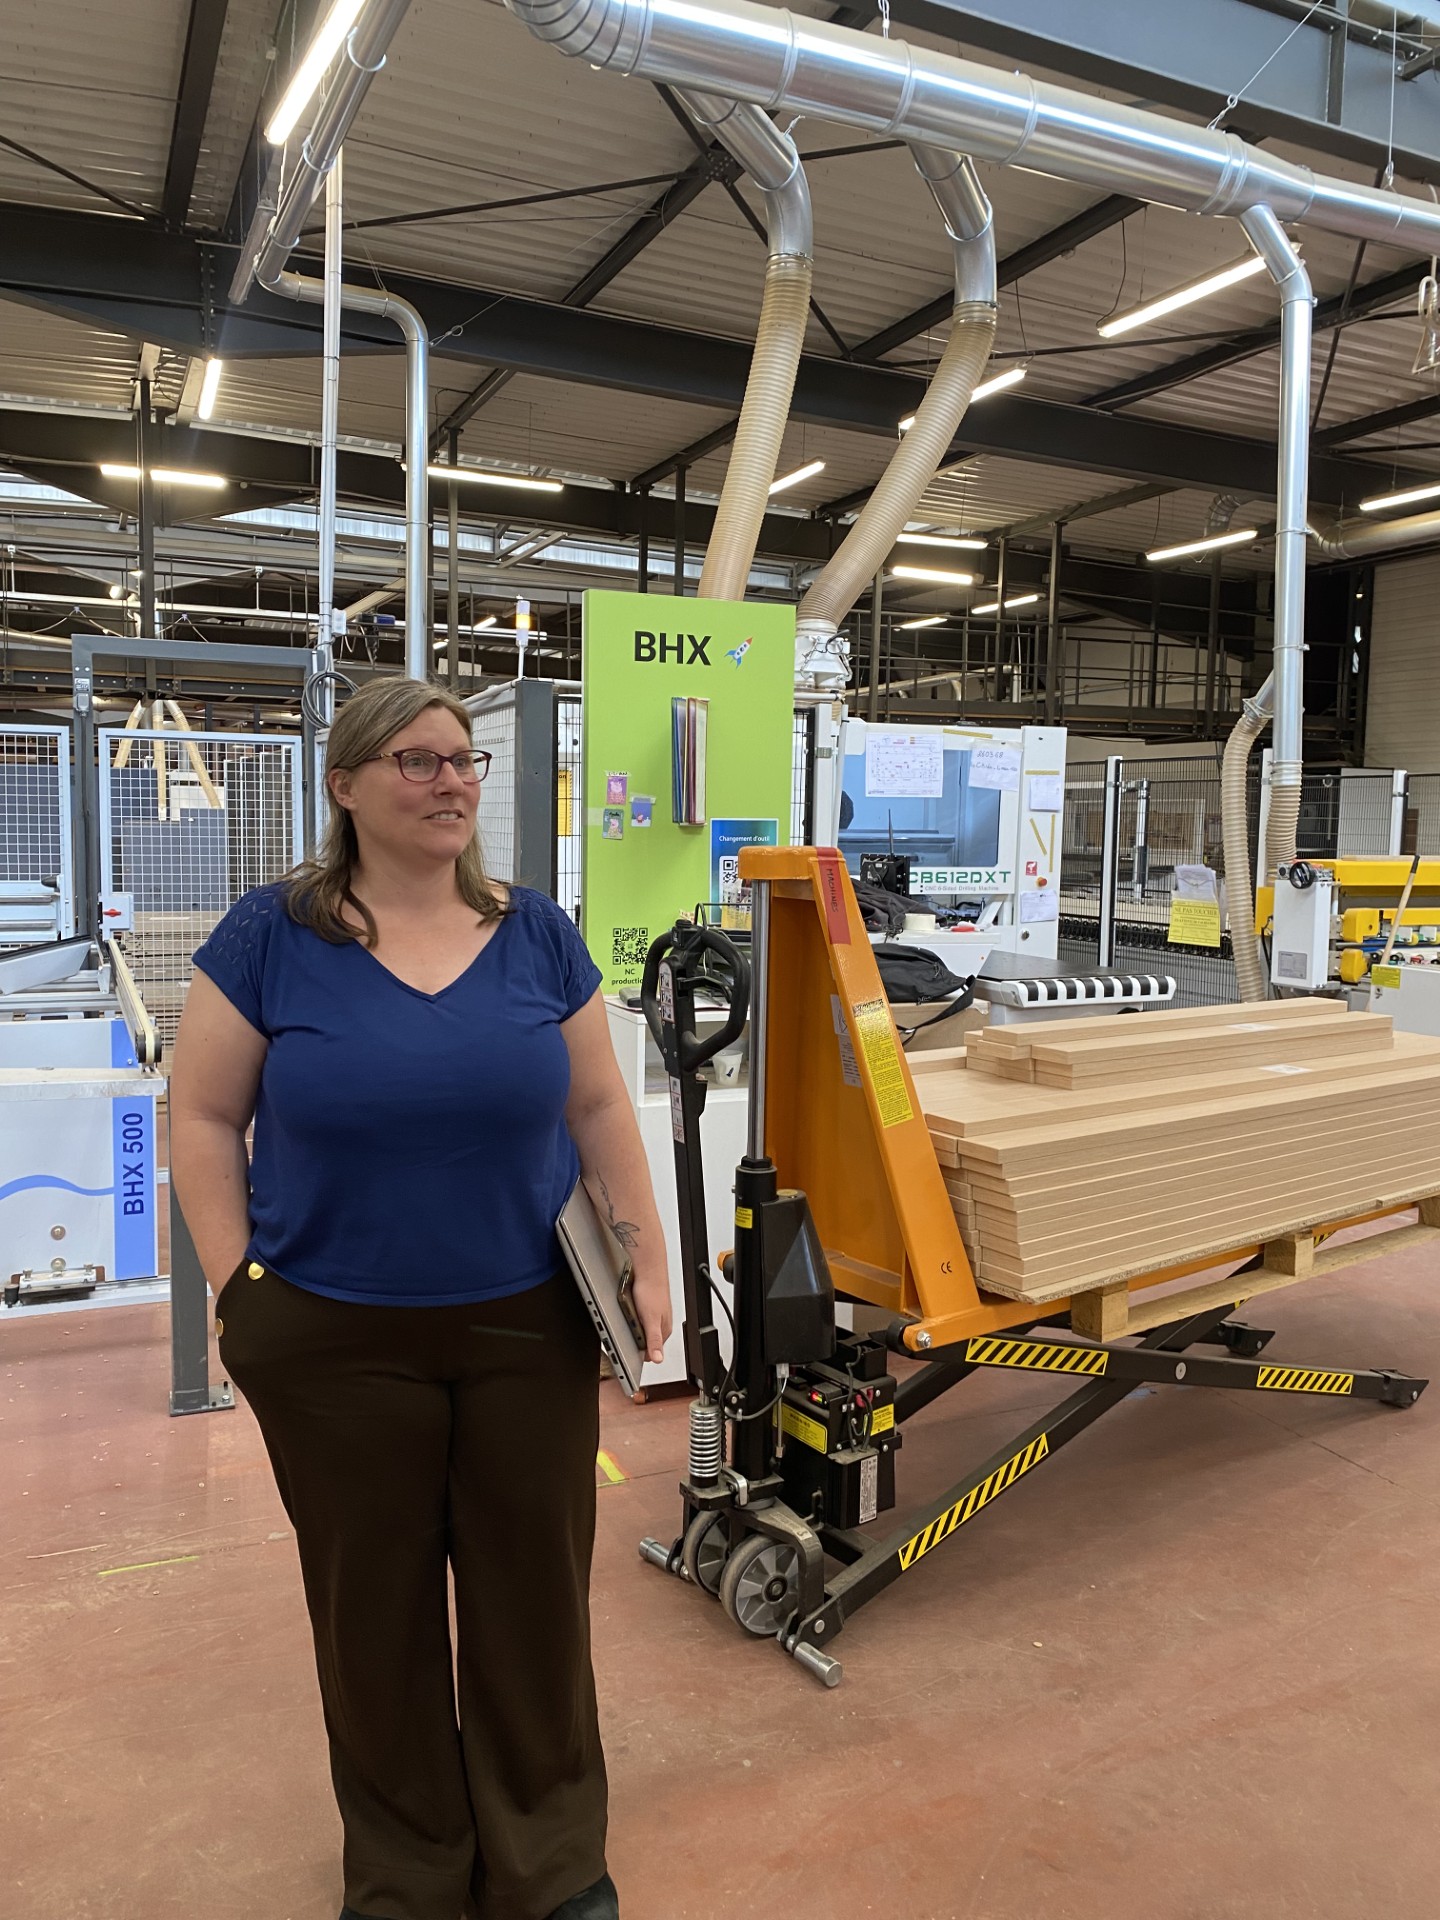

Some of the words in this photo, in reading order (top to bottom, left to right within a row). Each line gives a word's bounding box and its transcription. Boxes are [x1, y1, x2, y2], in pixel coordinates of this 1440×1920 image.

[634, 630, 712, 666] BHX
[718, 835, 753, 843] Changement
[611, 978, 643, 986] productio
[122, 1112, 144, 1154] 500
[122, 1162, 144, 1215] BHX
